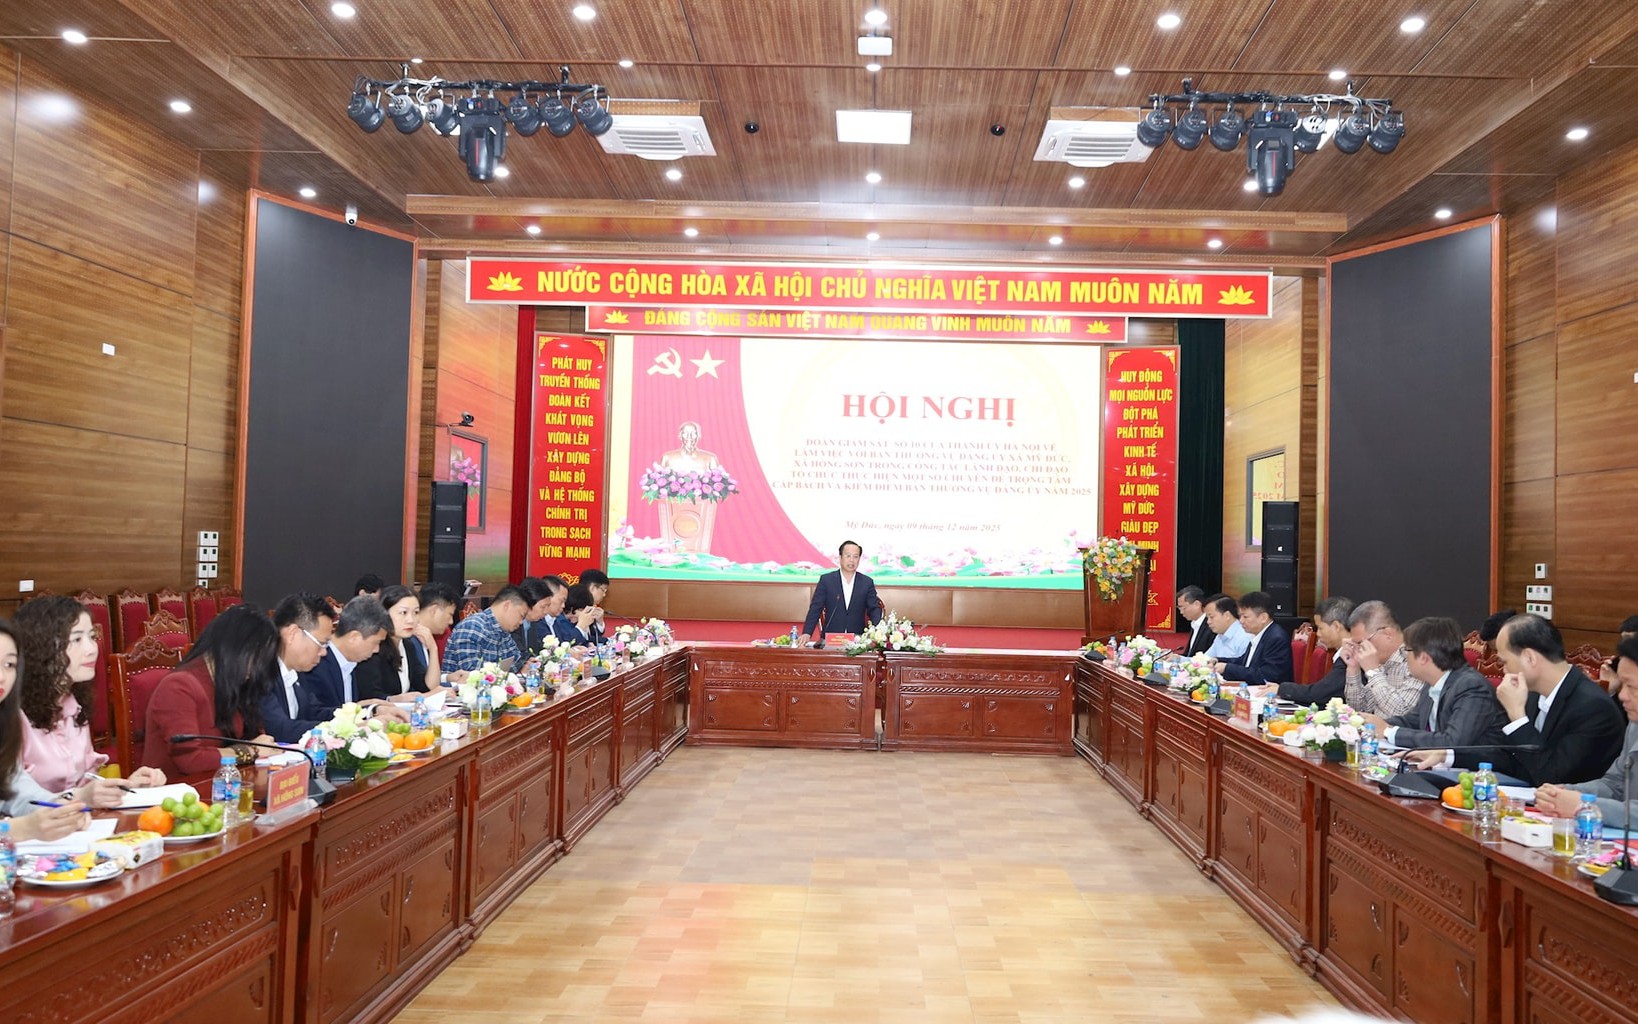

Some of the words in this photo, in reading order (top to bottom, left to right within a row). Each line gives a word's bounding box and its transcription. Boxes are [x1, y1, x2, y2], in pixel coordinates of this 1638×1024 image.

[537, 265, 601, 294] NƯỚC
[609, 268, 673, 298] CỘNG
[680, 269, 727, 296] HÒA
[735, 270, 766, 297] XÃ
[774, 270, 811, 302] HỘI
[820, 269, 867, 299] CHỦ
[875, 274, 946, 301] NGHĨA
[951, 275, 1000, 306] VIỆT
[1007, 279, 1062, 303] NAM
[1070, 276, 1140, 305] MUÔN
[1148, 277, 1203, 305] NĂM
[695, 311, 741, 329] CỘNG
[786, 311, 822, 331] VIỆT
[825, 314, 865, 330] NAM
[931, 316, 971, 332] VINH
[976, 315, 1026, 333] MUÔN
[1031, 315, 1071, 334] NĂM
[552, 355, 573, 370] PHÁT
[576, 358, 592, 371] HUY
[573, 373, 601, 390] THỐNG
[1121, 371, 1137, 382] HUY
[1139, 367, 1162, 385] ĐỘNG
[548, 392, 572, 407] ĐOÀN
[574, 392, 590, 408] KẾT
[1109, 389, 1125, 404] MỌI
[1157, 388, 1173, 404] LỰC
[842, 390, 909, 425] HỘI
[921, 394, 1016, 428] NGHỊ
[1123, 405, 1139, 423] ĐỘT
[1141, 406, 1158, 420] PHÁ
[545, 411, 567, 426] KHÁT
[570, 414, 594, 429] VỌNG
[547, 431, 572, 445] VƯƠN
[573, 430, 589, 445] LÊN
[1117, 424, 1138, 439] PHÁT
[1139, 421, 1164, 439] TRIỂN
[546, 449, 564, 463] XÂY
[566, 450, 590, 466] DỰNG
[1124, 445, 1144, 458] KINH
[1146, 441, 1157, 458] TẾ
[549, 465, 572, 483] ĐẢNG
[574, 468, 586, 486] BỘ
[1125, 462, 1138, 477] XÃ
[1140, 463, 1155, 479] HỘI
[539, 486, 550, 501] VÀ
[554, 486, 565, 504] HỆ
[567, 486, 595, 502] THỐNG
[1071, 487, 1092, 496] 2025
[1119, 482, 1135, 496] XÂY
[1137, 483, 1159, 498] DỰNG
[545, 505, 571, 520] CHÍNH
[574, 507, 587, 522] TRỊ
[1123, 500, 1136, 515] MỸ
[1138, 499, 1155, 515] ĐỨC
[540, 526, 569, 539] TRONG
[569, 527, 591, 542] SẠCH
[947, 521, 957, 530] 12
[980, 522, 1001, 532] 2025
[1121, 518, 1140, 533] GIÀU
[1142, 521, 1159, 536] ĐẸP
[539, 544, 563, 558] VỮNG
[565, 546, 591, 561] MẠNH
